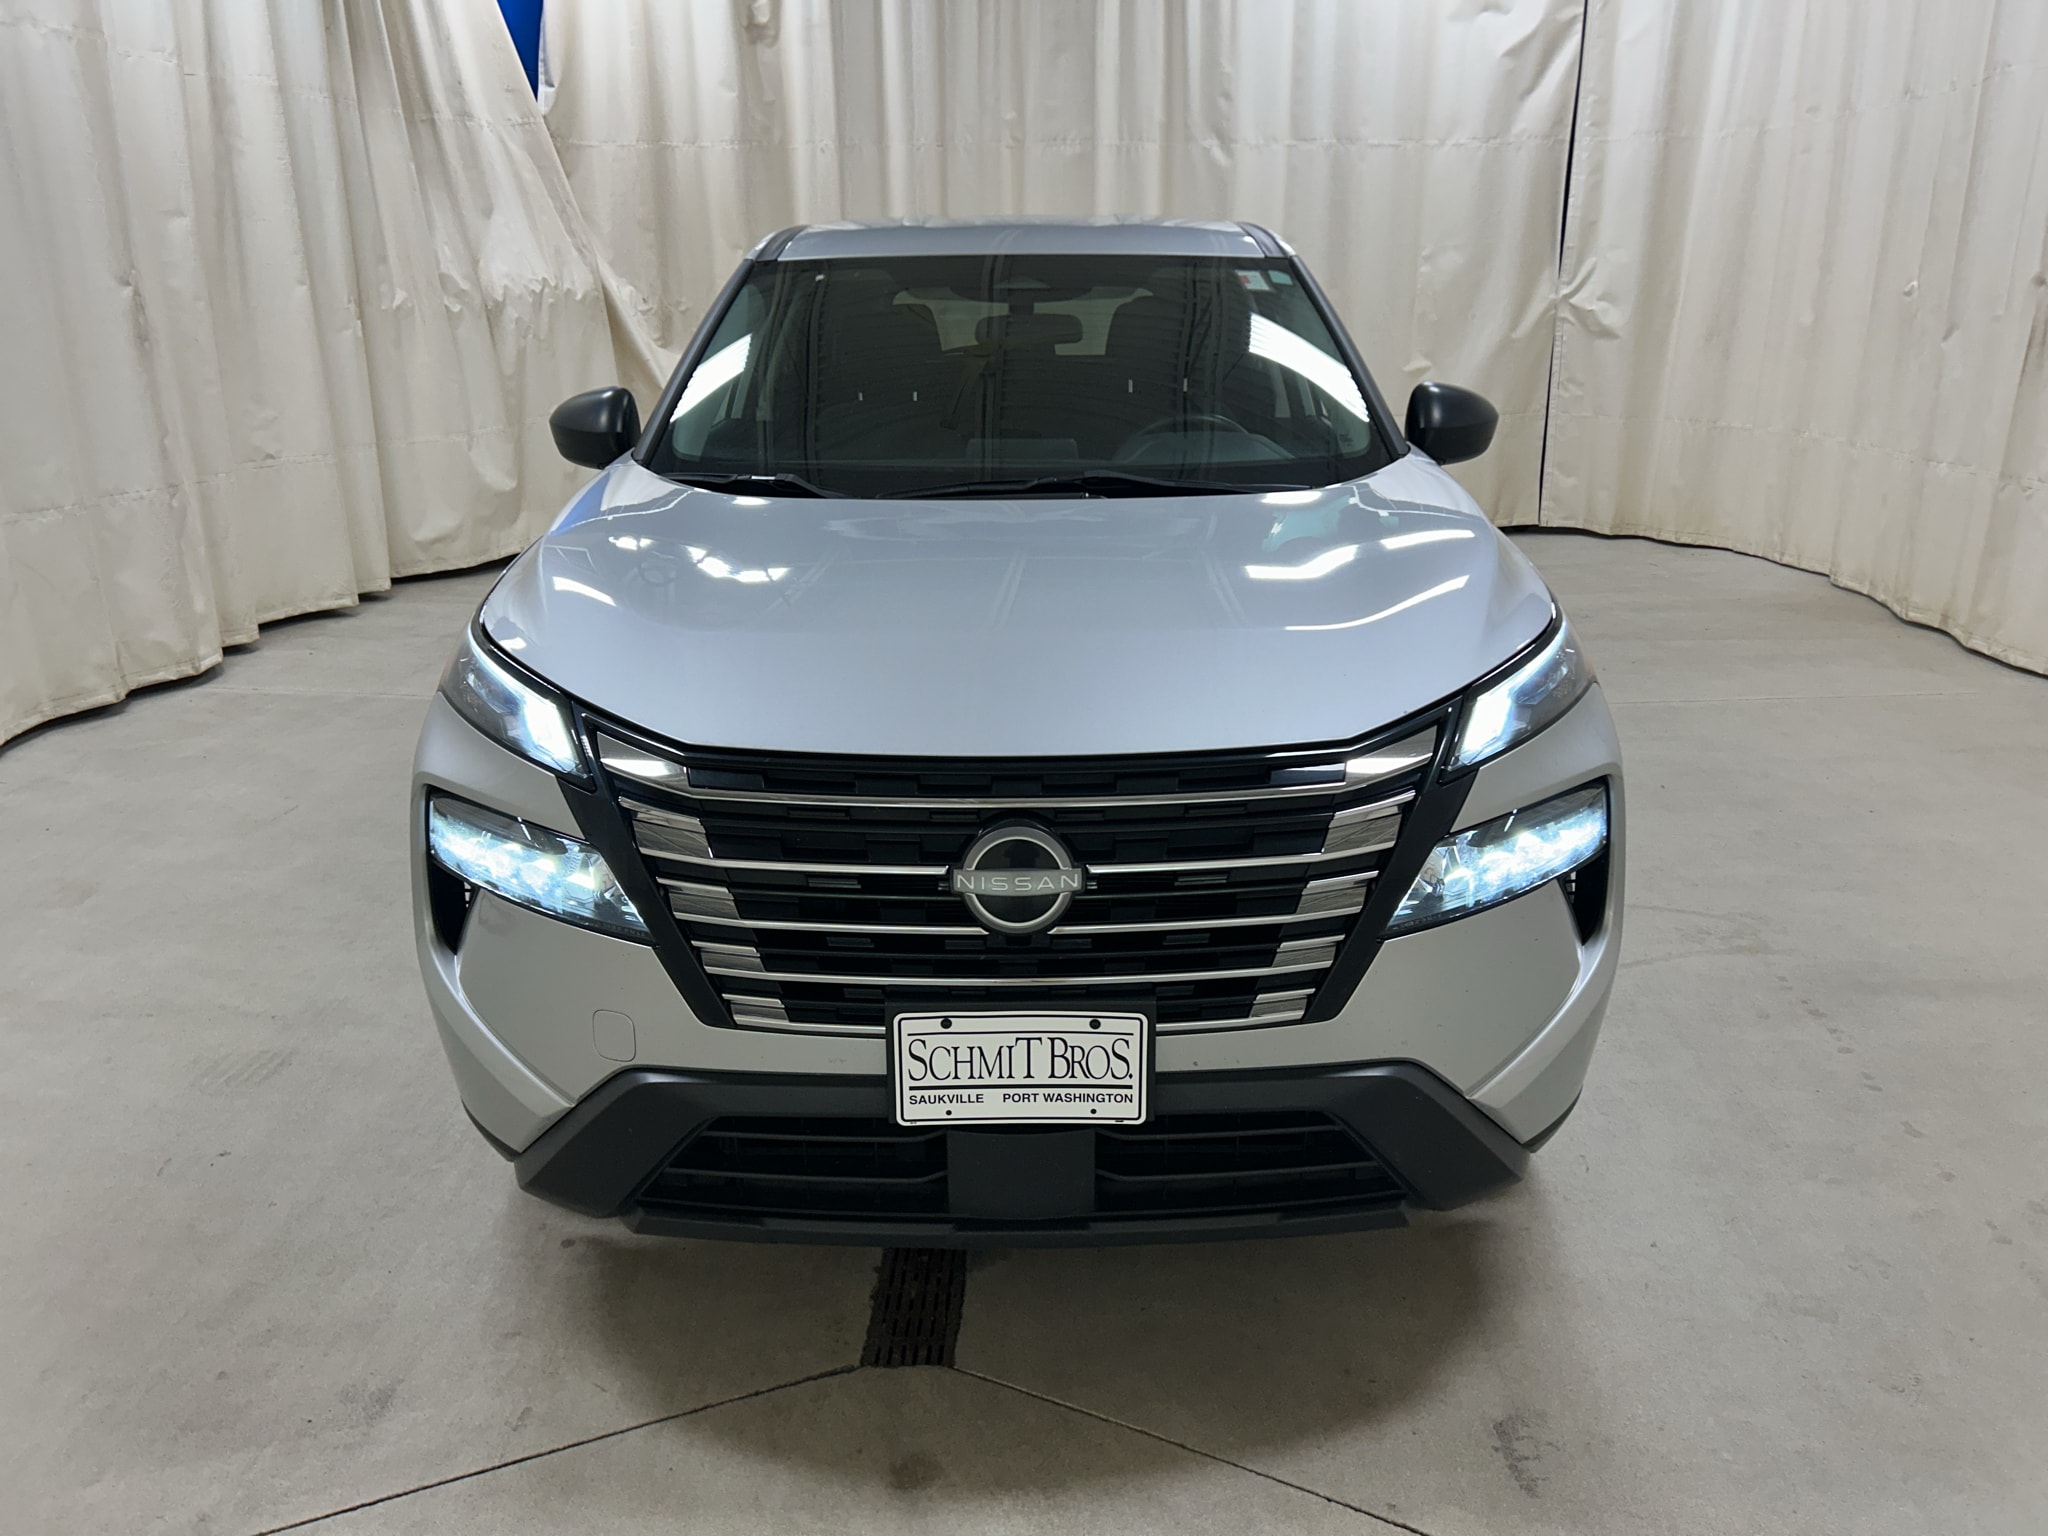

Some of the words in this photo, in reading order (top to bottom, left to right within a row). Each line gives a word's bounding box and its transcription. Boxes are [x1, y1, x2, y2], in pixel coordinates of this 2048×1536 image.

[957, 873, 1078, 891] NISSAN
[908, 1037, 1042, 1081] SCHMIT
[1047, 1037, 1133, 1080] BROS.
[909, 1093, 984, 1105] SAUKVILLE
[1002, 1093, 1039, 1103] PORT
[1043, 1093, 1133, 1104] WASHINGTON
